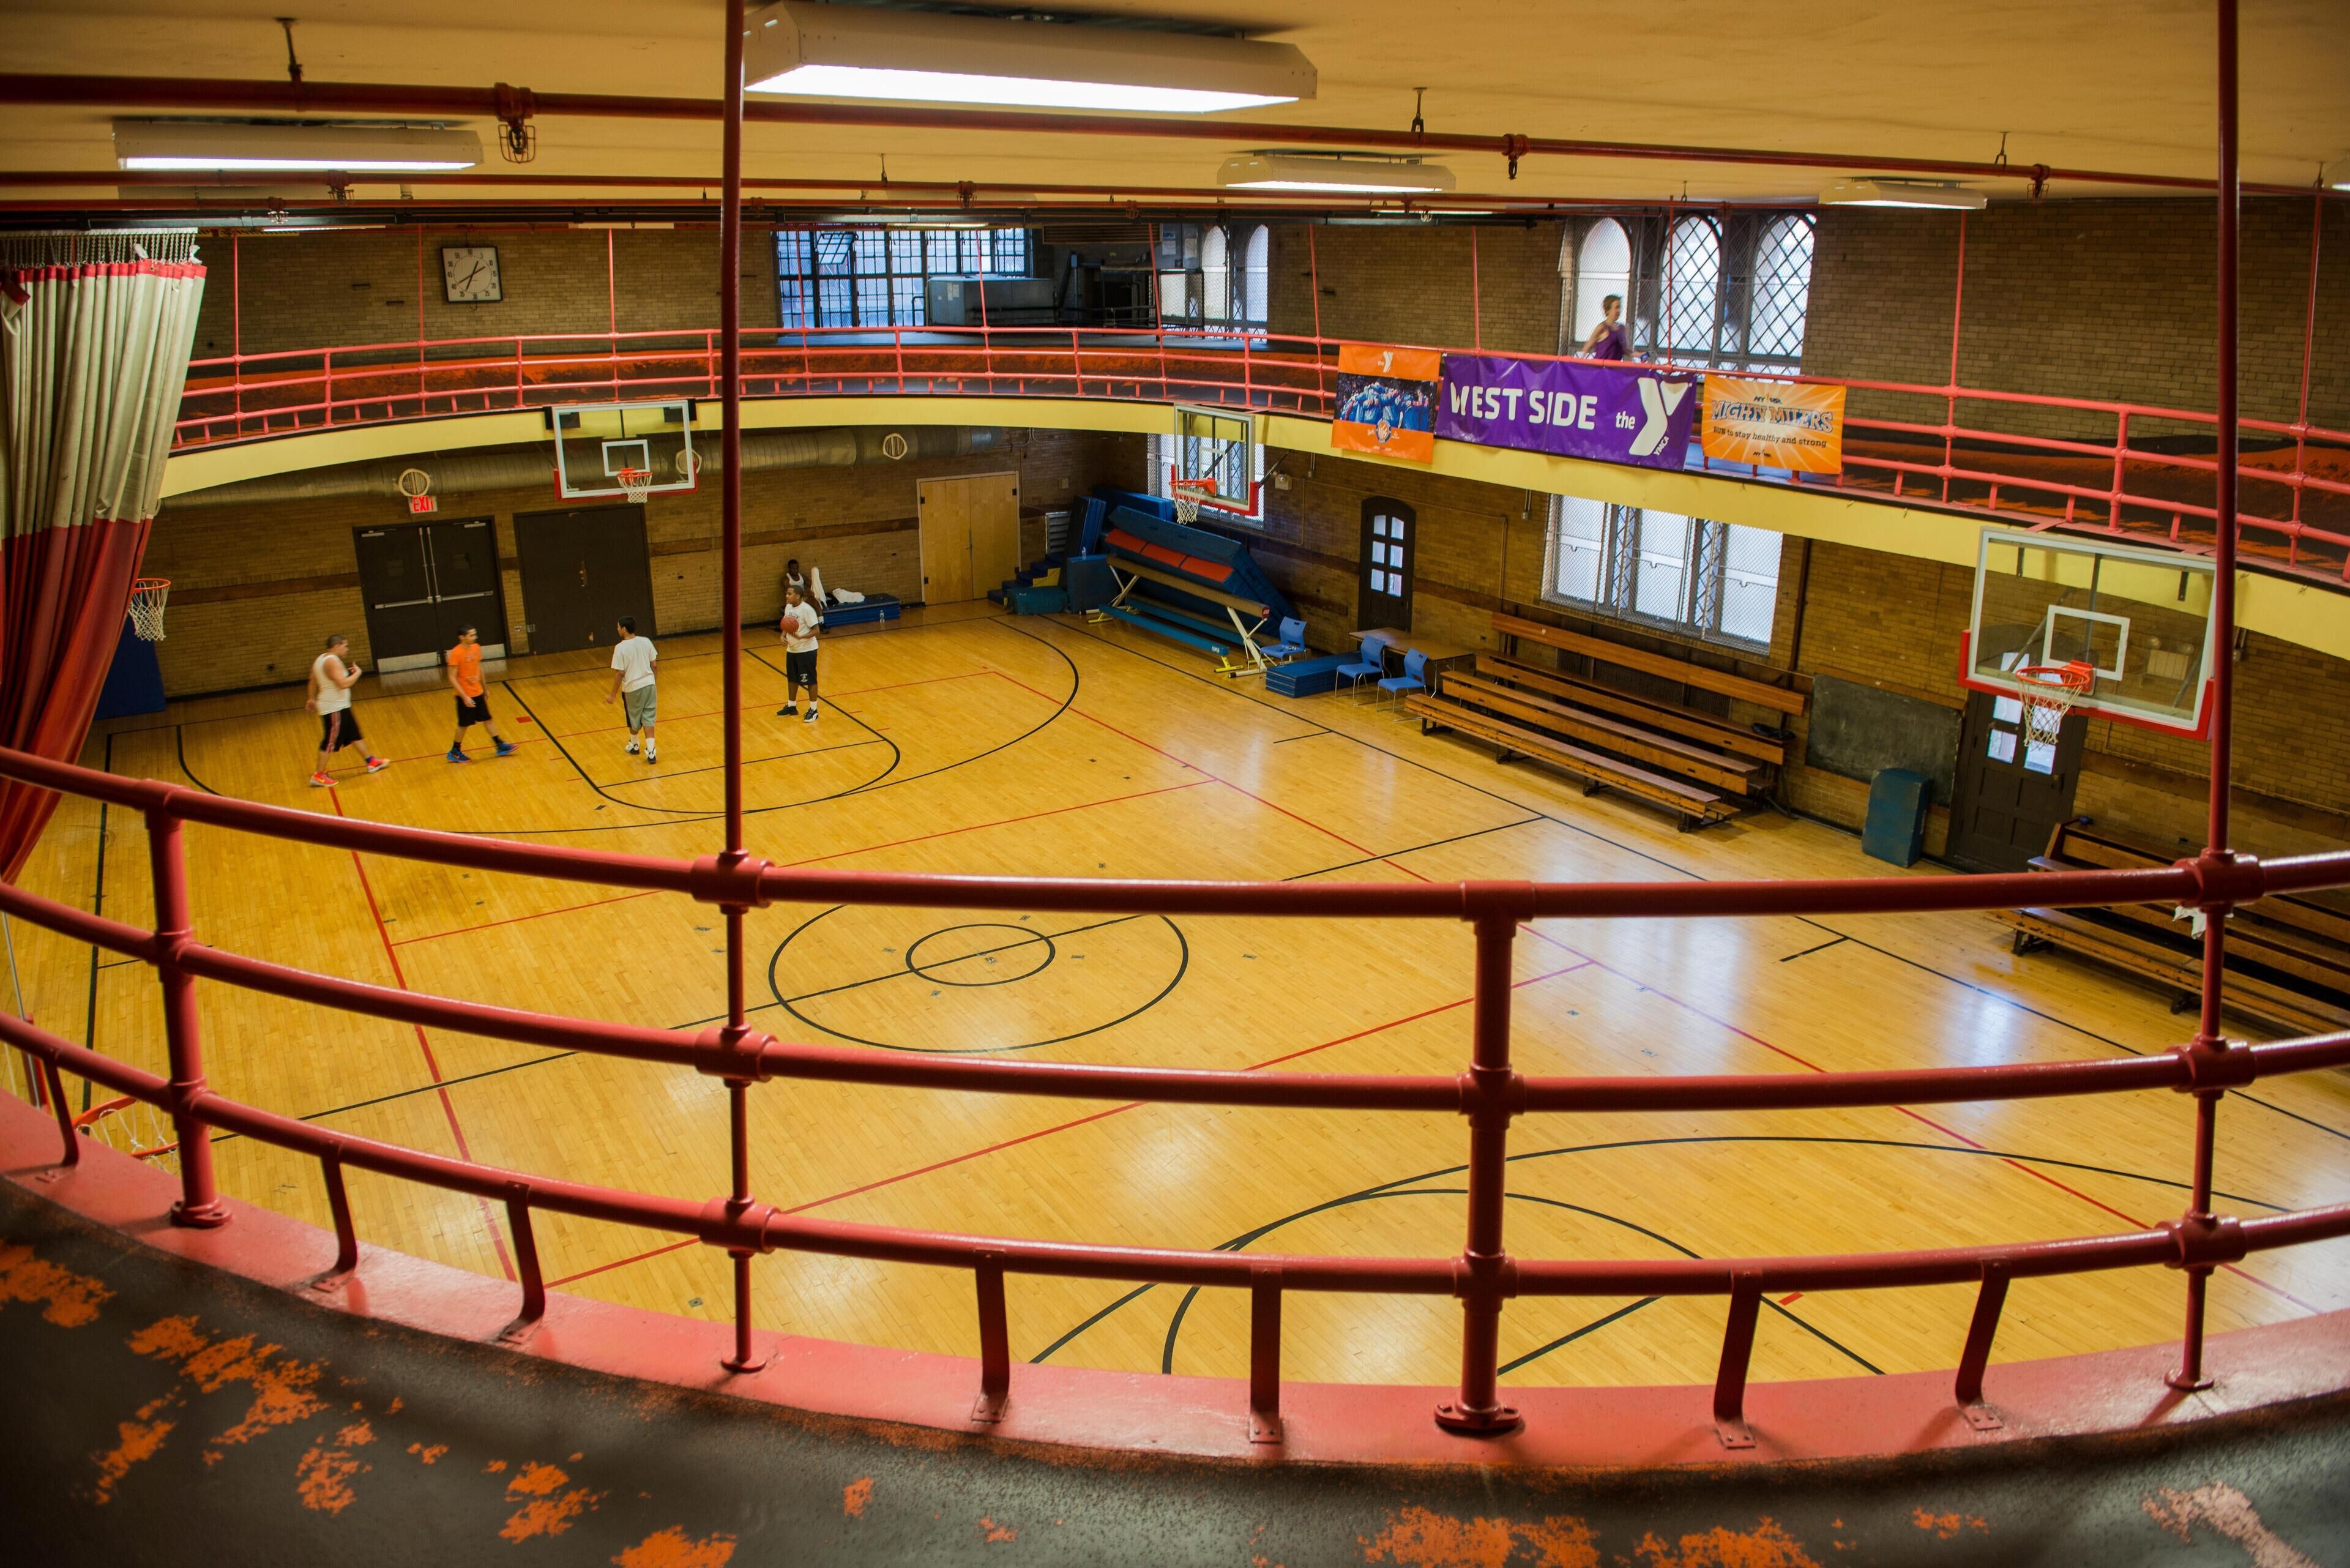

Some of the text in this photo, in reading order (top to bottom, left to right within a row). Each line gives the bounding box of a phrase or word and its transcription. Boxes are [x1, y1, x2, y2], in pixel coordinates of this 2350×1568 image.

[1450, 381, 1598, 430] WEST SIDE
[1710, 400, 1833, 433] MIGHTY MILERS
[1616, 411, 1636, 430] the
[1654, 436, 1669, 455] YMCA
[1714, 426, 1726, 435] RUN
[1734, 431, 1753, 440] stay
[1752, 432, 1780, 444] healthy
[1798, 437, 1827, 448] strong
